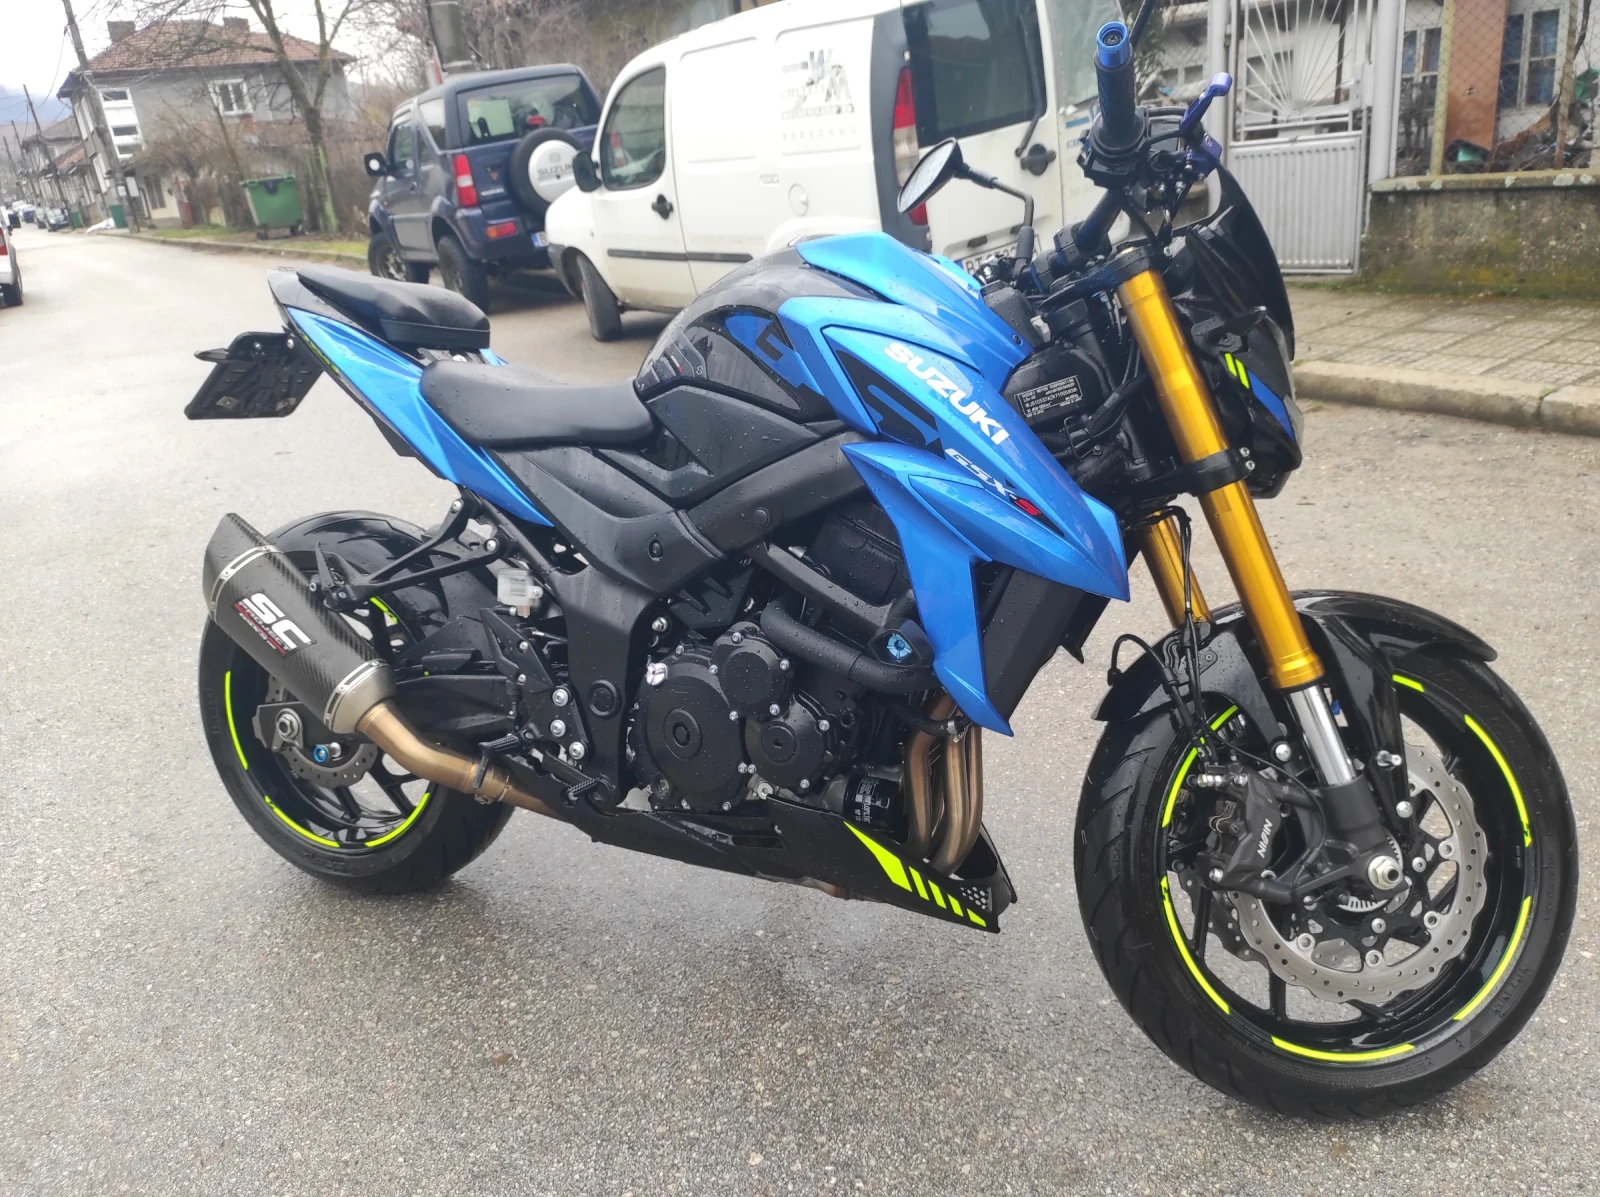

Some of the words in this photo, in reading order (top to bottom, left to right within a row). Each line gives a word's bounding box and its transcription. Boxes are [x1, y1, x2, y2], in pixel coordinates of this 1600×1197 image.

[884, 342, 1010, 445] SUZUKI
[944, 448, 1041, 516] GSX-S
[242, 593, 312, 649] SC
